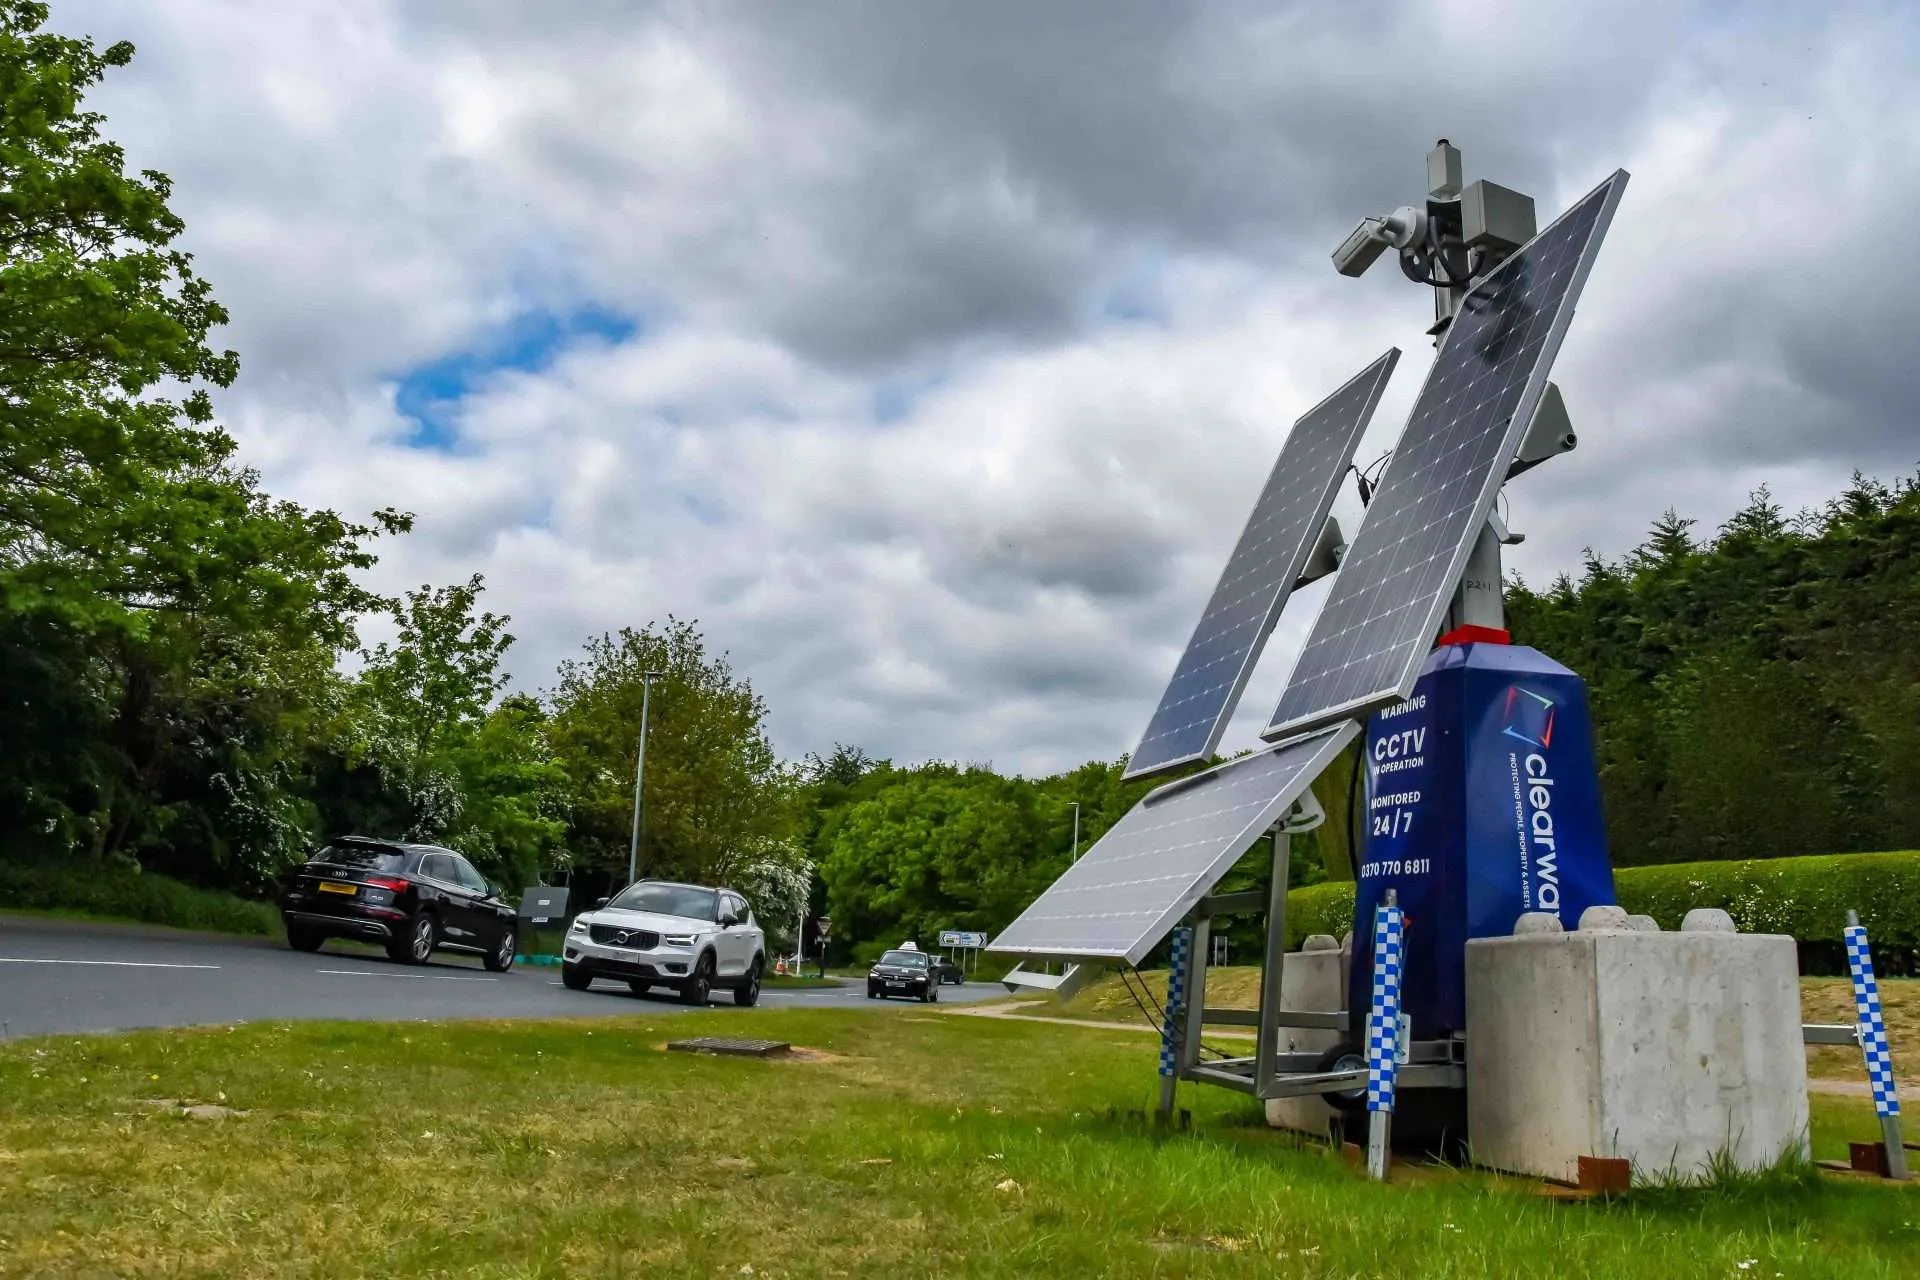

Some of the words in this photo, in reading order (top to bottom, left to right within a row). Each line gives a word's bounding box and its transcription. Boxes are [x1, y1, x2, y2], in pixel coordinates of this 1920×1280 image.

[1381, 694, 1426, 720] WARNING
[1375, 726, 1426, 761] CCTV
[1380, 756, 1424, 774] OPERATION
[1509, 753, 1521, 800] PROTECTING
[1371, 791, 1421, 810] MONITORED
[1373, 807, 1413, 838] 24/7
[1525, 753, 1560, 918] clearwa
[1518, 831, 1528, 870] PROPERTY
[1361, 862, 1380, 879] 0370
[1382, 860, 1401, 876] 770
[1404, 858, 1430, 875] 6811
[1522, 879, 1531, 909] ASSETS
